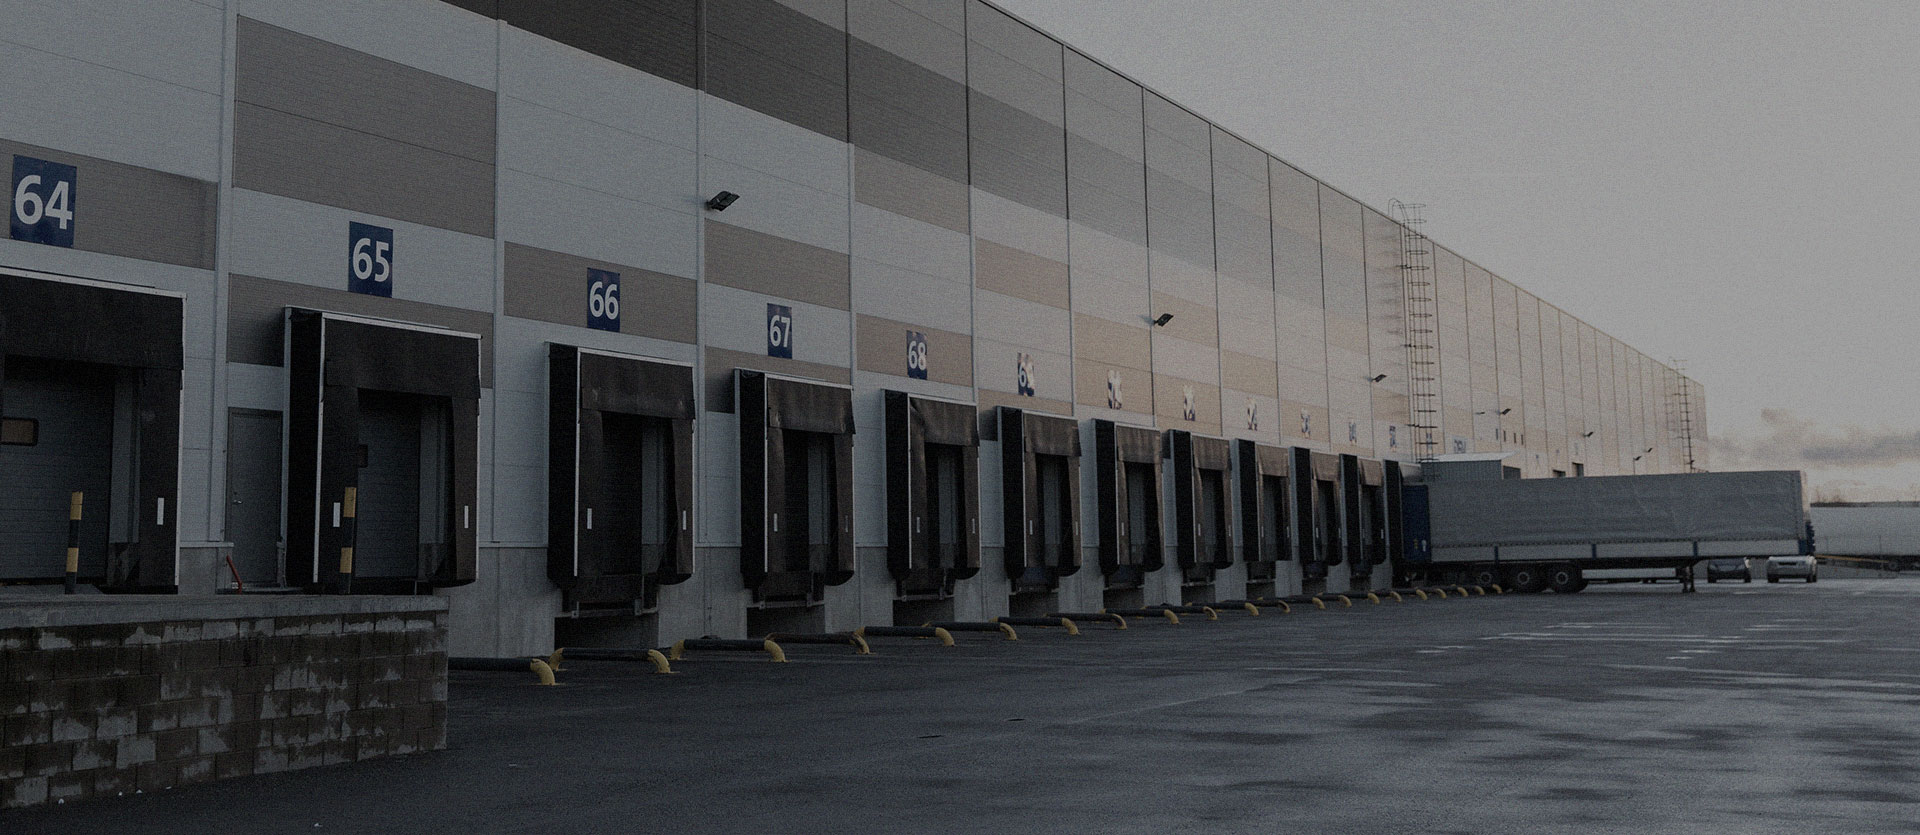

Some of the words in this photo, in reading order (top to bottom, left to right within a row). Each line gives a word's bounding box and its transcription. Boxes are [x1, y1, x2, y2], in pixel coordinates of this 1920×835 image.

[15, 175, 73, 230] 64
[353, 238, 390, 283] 65
[590, 281, 619, 319] 66
[769, 314, 791, 347] 67
[908, 340, 927, 370] 68
[1019, 362, 1035, 388] 6
